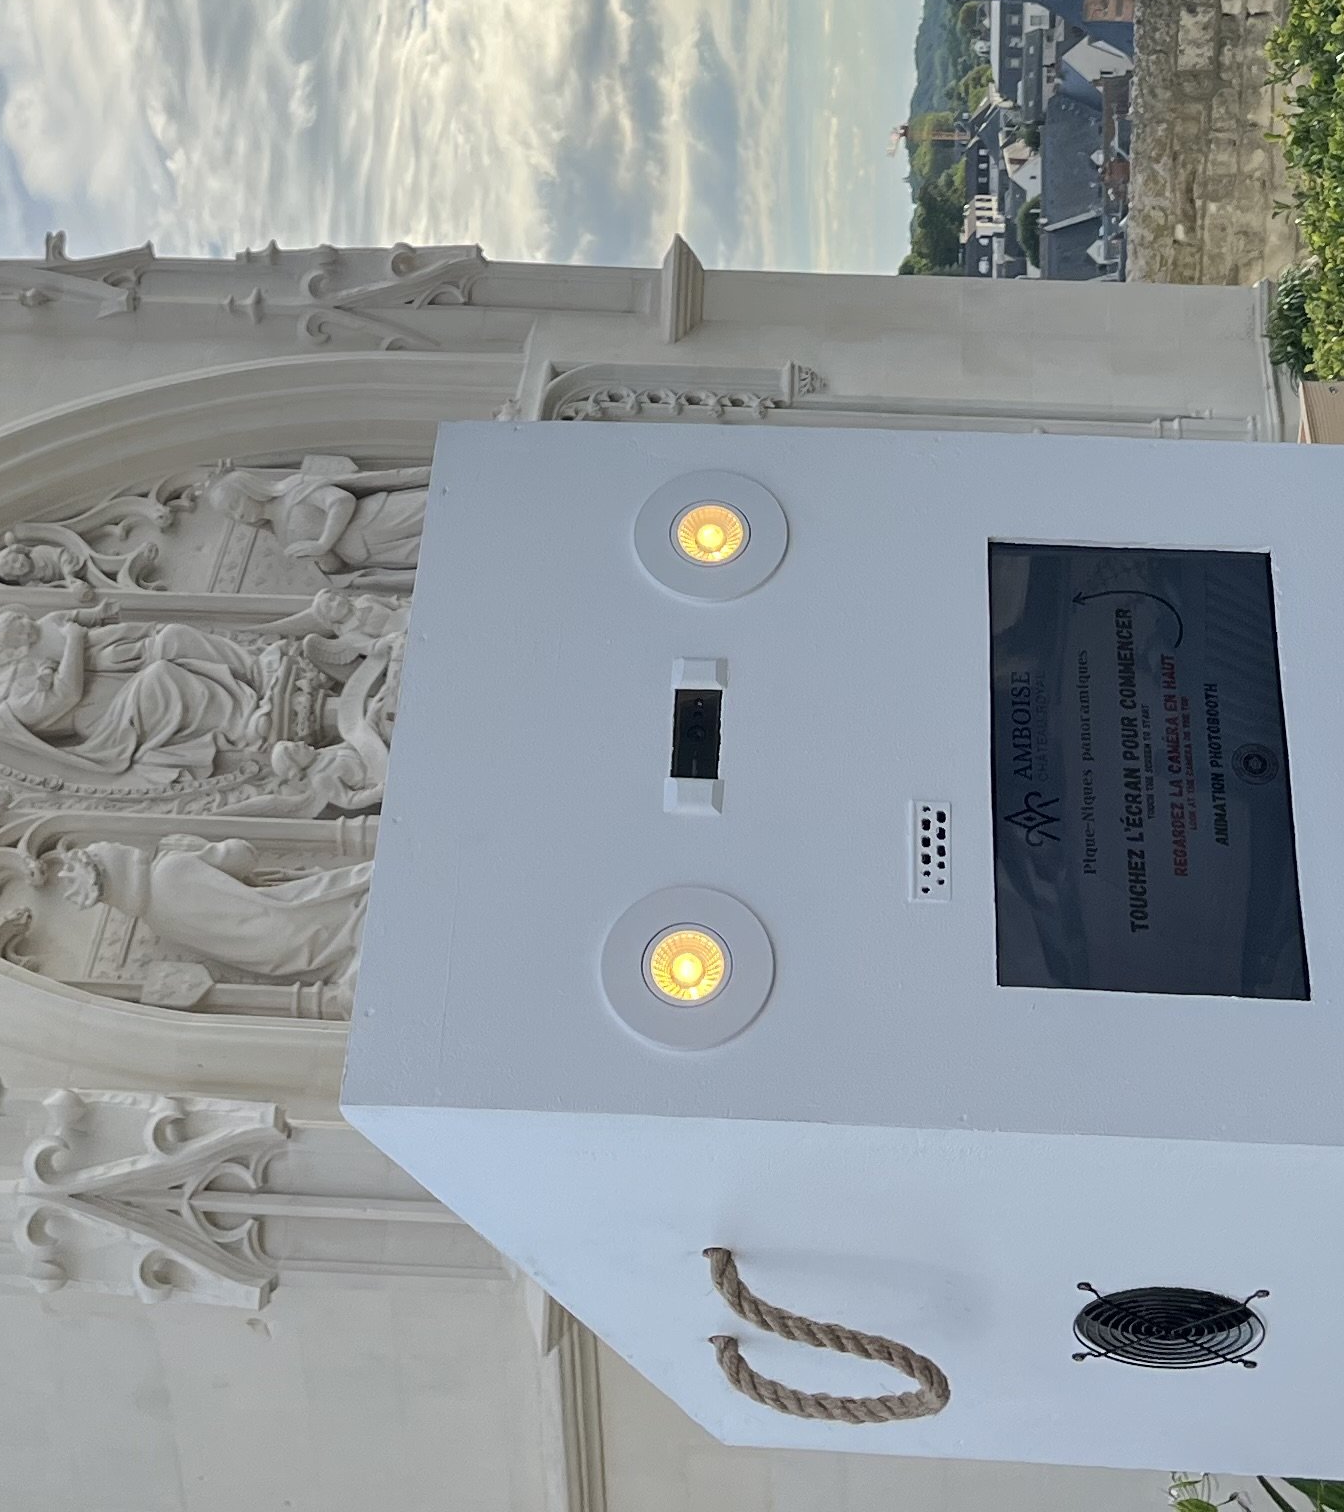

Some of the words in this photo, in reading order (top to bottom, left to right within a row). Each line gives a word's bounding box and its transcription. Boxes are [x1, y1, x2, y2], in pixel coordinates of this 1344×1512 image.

[1115, 608, 1136, 709] COMMENCER
[1160, 654, 1176, 690] HAUT
[1011, 672, 1032, 781] AMBOISE
[1076, 650, 1094, 761] panoramiques
[1120, 717, 1139, 760] POUR
[1141, 704, 1151, 728] START
[1143, 732, 1151, 740] TO
[1163, 695, 1178, 711] EN
[1204, 683, 1223, 768] PHOTOBOOTH
[1161, 717, 1182, 774] CAMÉRA
[1081, 769, 1097, 875] Pique-Niques
[1120, 768, 1145, 842] L'ÉCRAN
[1168, 780, 1183, 797] LA
[1211, 773, 1229, 846] ANIMATION
[1170, 803, 1188, 876] REGARDEZ
[1127, 848, 1149, 933] TOUCHEZ
